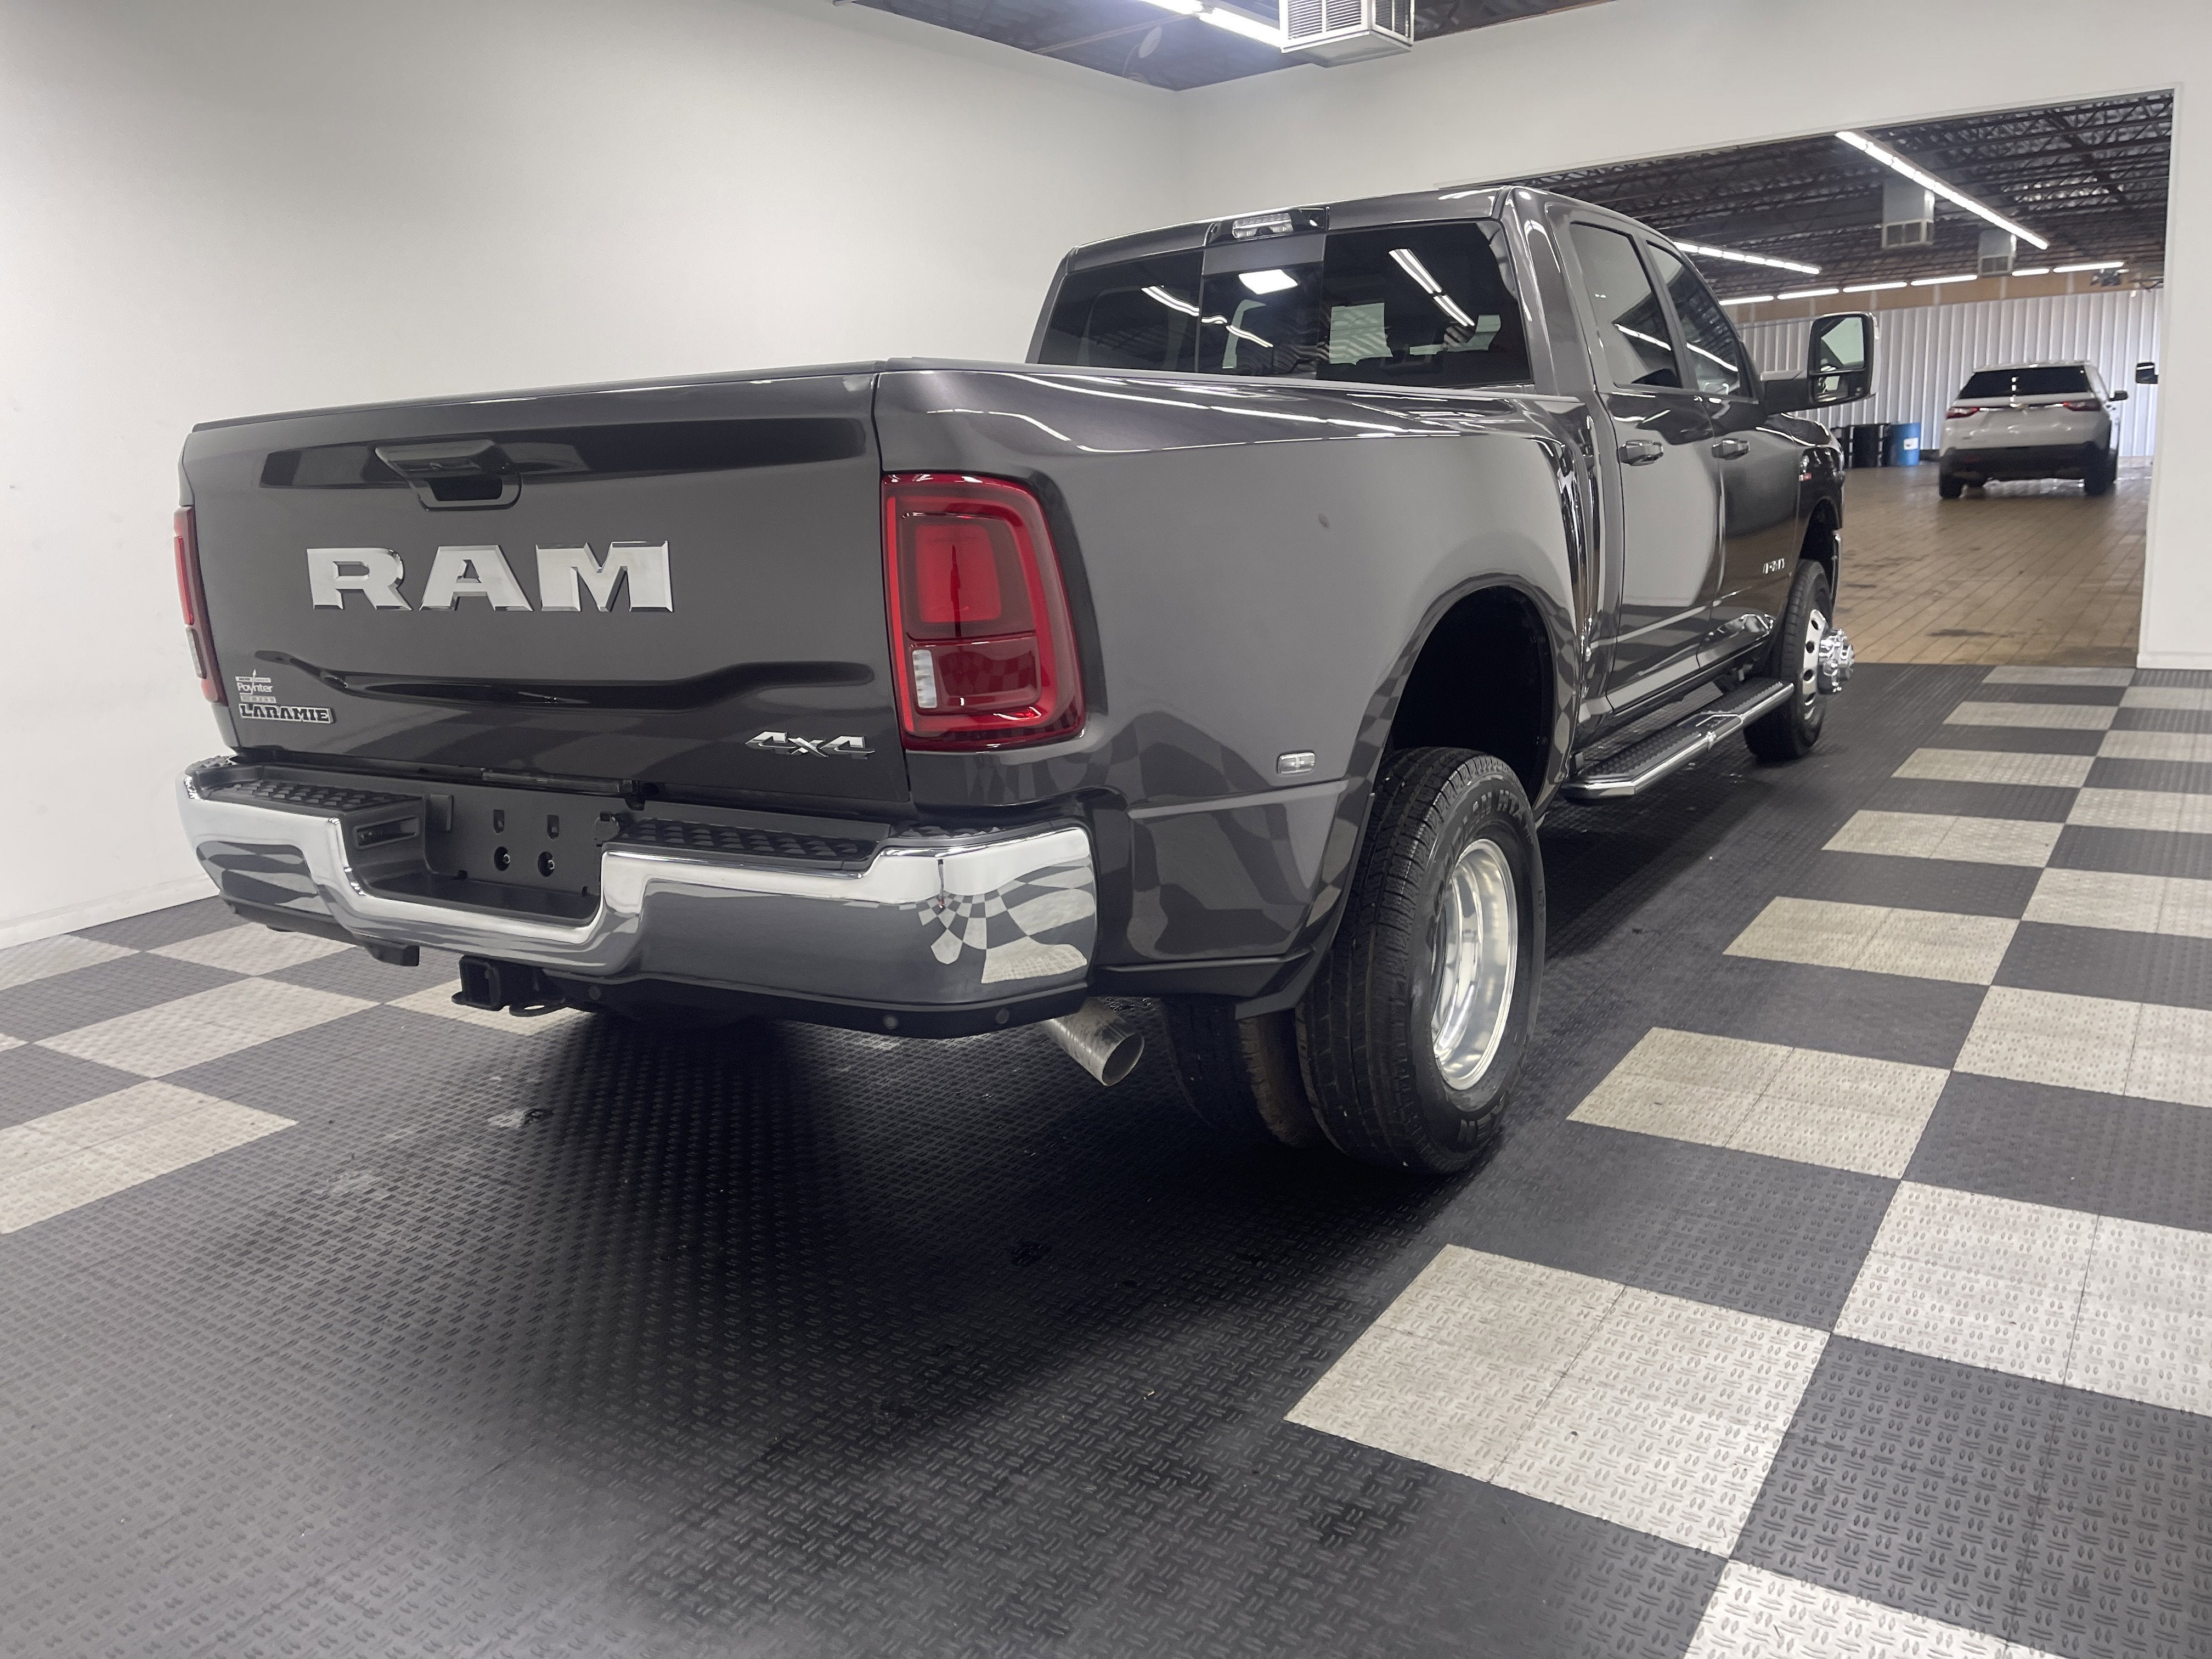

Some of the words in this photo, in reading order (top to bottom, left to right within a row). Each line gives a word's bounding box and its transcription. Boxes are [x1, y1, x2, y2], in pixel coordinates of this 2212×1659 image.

[307, 541, 673, 612] RAM
[237, 682, 273, 695] Poynter
[239, 703, 332, 724] LARAMIE
